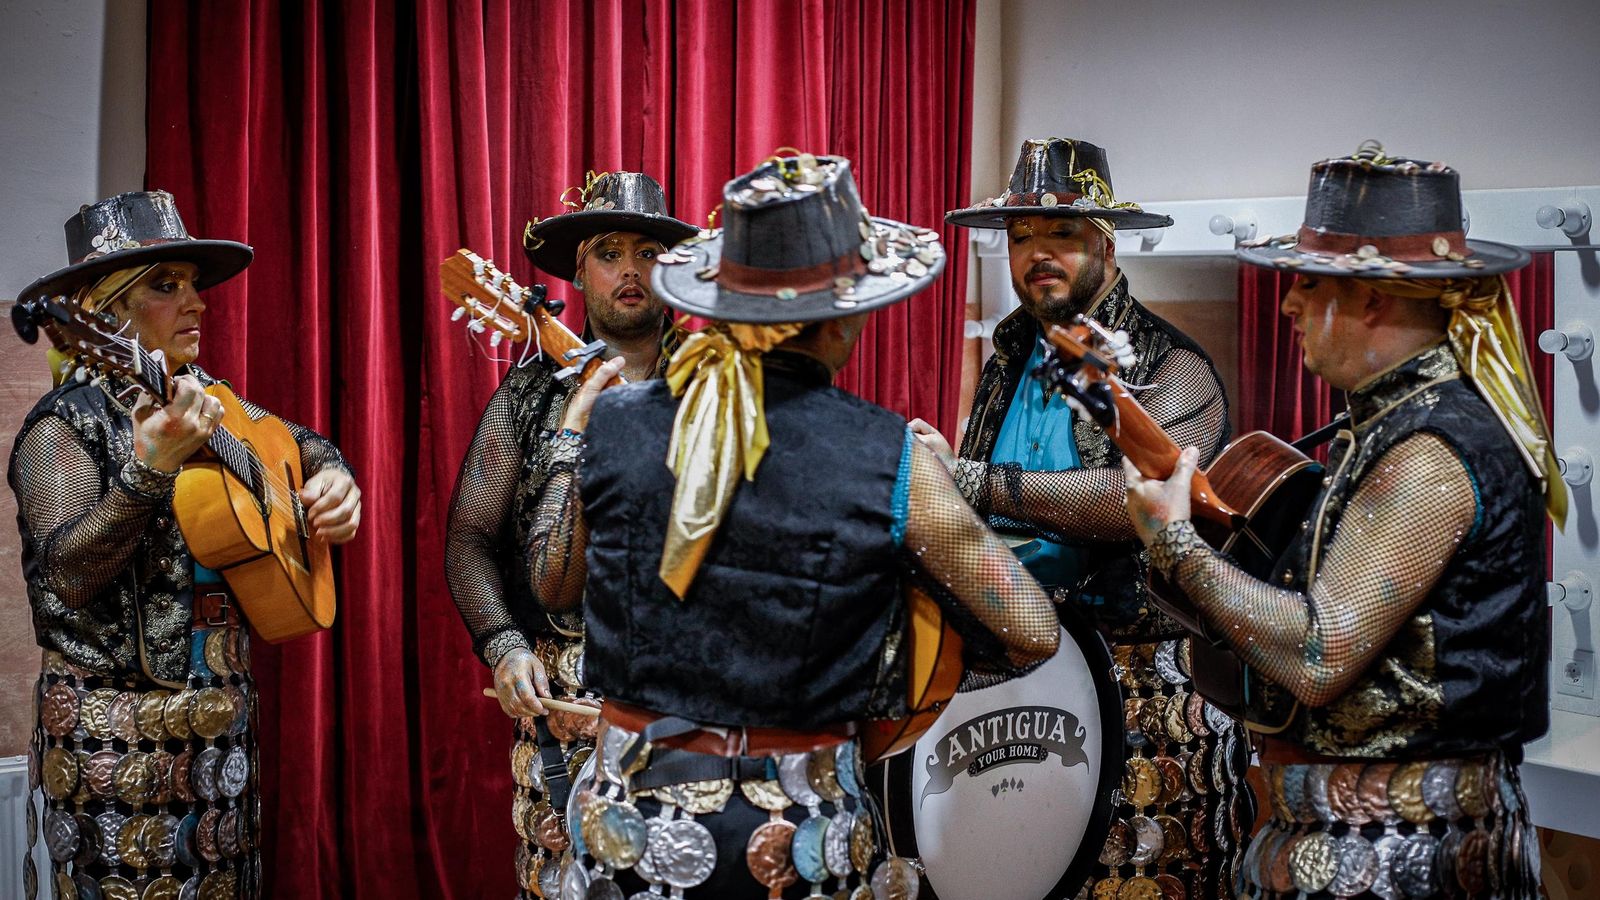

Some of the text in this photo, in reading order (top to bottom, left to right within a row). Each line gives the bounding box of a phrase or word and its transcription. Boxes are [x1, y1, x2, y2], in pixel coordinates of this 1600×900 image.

[947, 711, 1066, 767] ANTIGUA
[978, 745, 1039, 768] YOUR HOME
